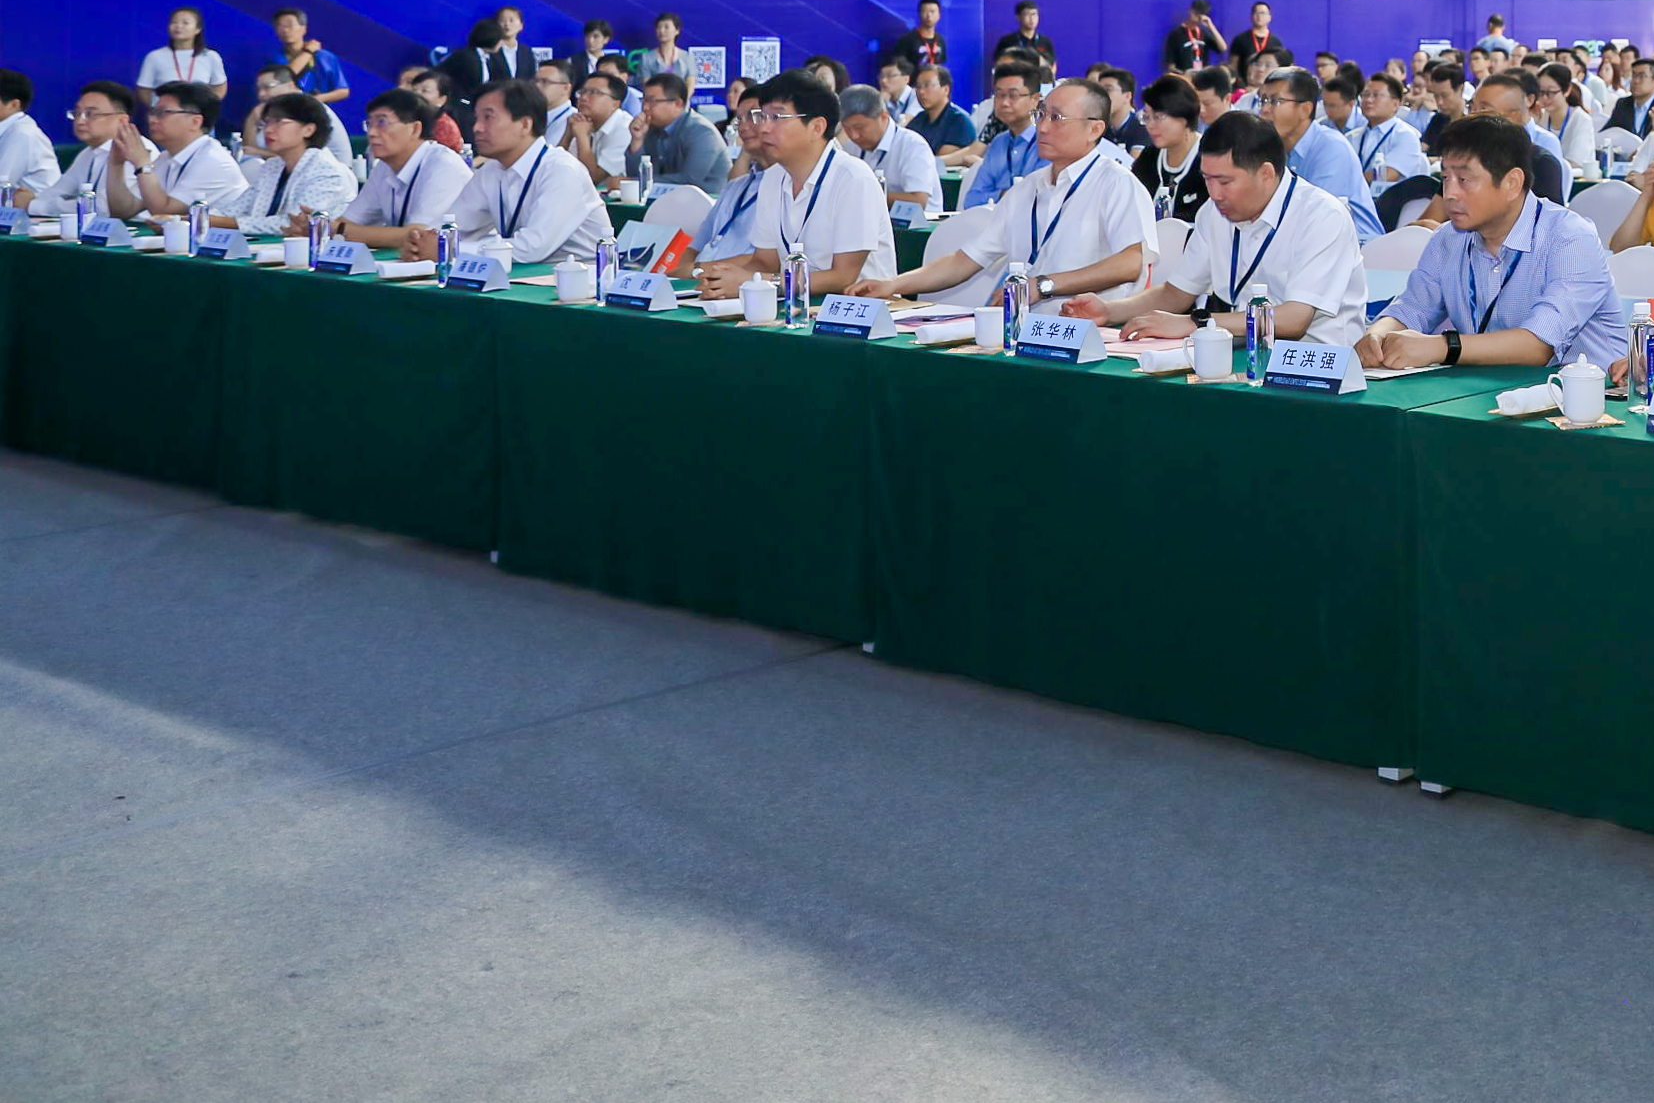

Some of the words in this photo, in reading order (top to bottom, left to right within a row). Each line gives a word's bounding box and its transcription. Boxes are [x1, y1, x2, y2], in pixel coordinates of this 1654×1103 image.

[828, 300, 870, 318] 杨子江
[1031, 320, 1076, 341] 张华林
[1282, 348, 1337, 370] 任洪强
